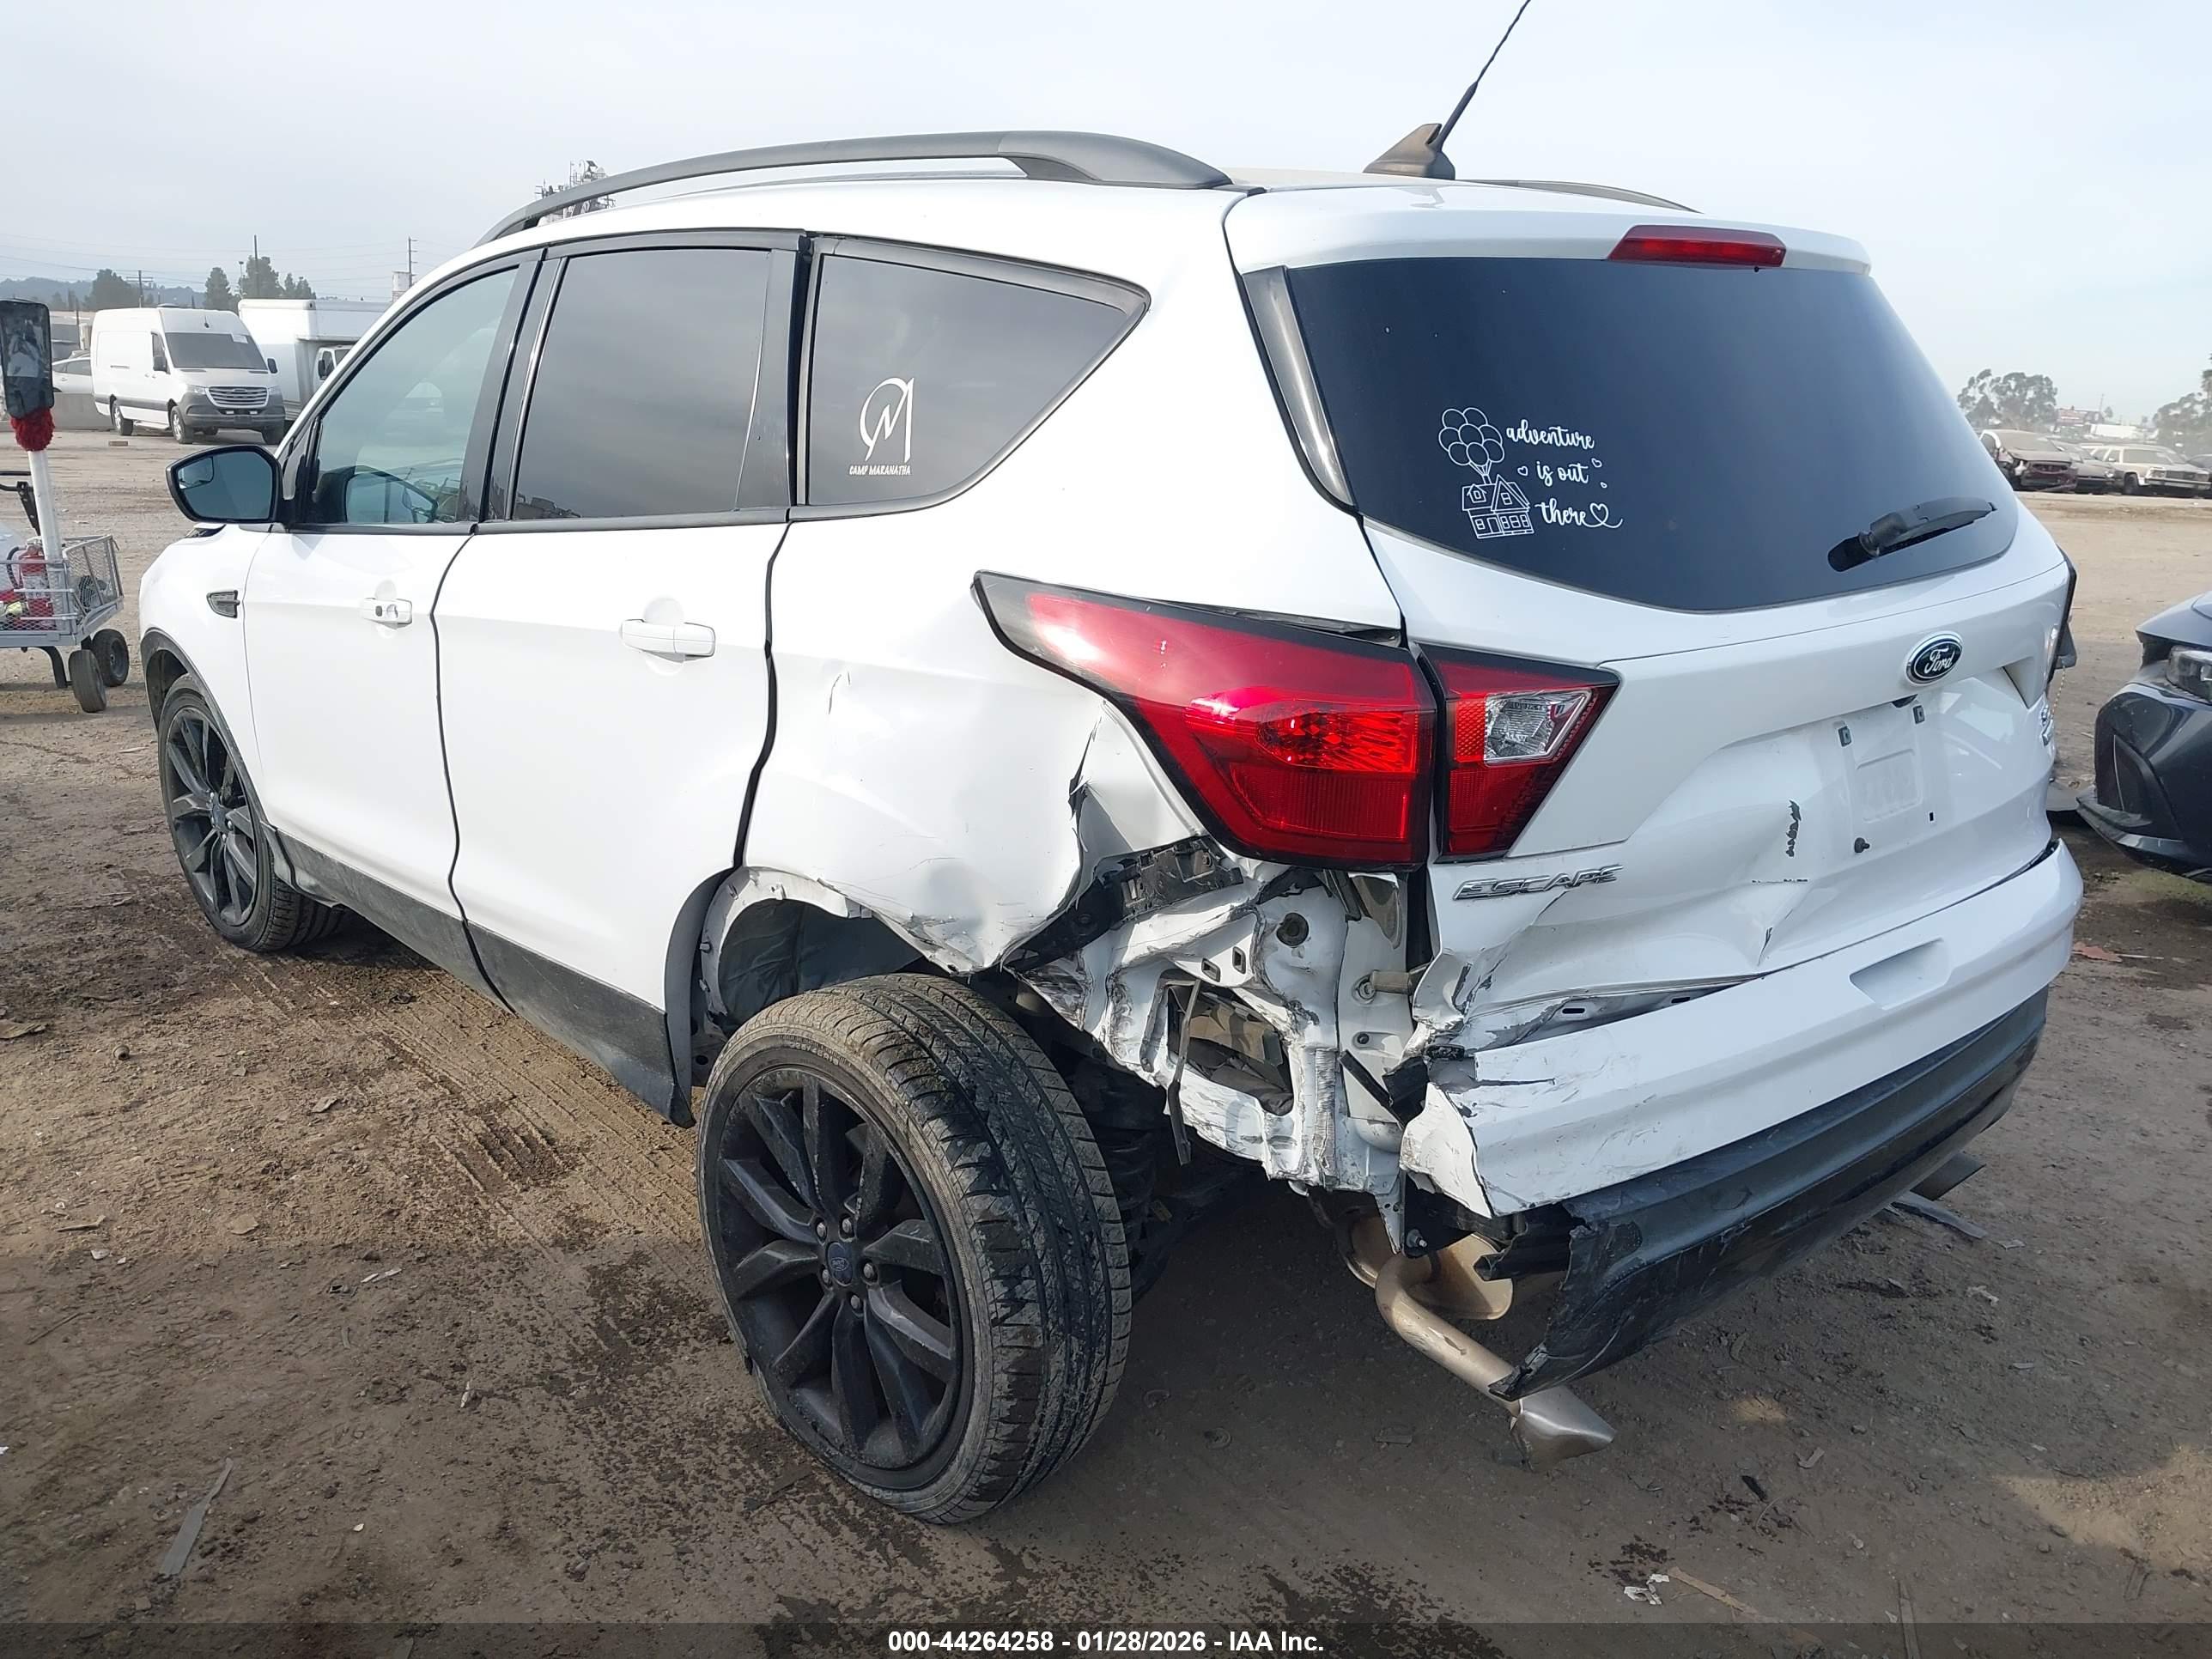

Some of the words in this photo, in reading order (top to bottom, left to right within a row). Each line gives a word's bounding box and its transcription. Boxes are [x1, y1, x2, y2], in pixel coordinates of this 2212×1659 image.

[1505, 419, 1595, 450] adventure
[849, 465, 869, 476] CAMP
[869, 465, 911, 476] MARANATHA
[1536, 461, 1553, 487] is
[1557, 463, 1589, 483] out
[1534, 498, 1587, 526] there
[1924, 647, 1956, 674] Ford
[1452, 864, 1624, 901] ESCAPE
